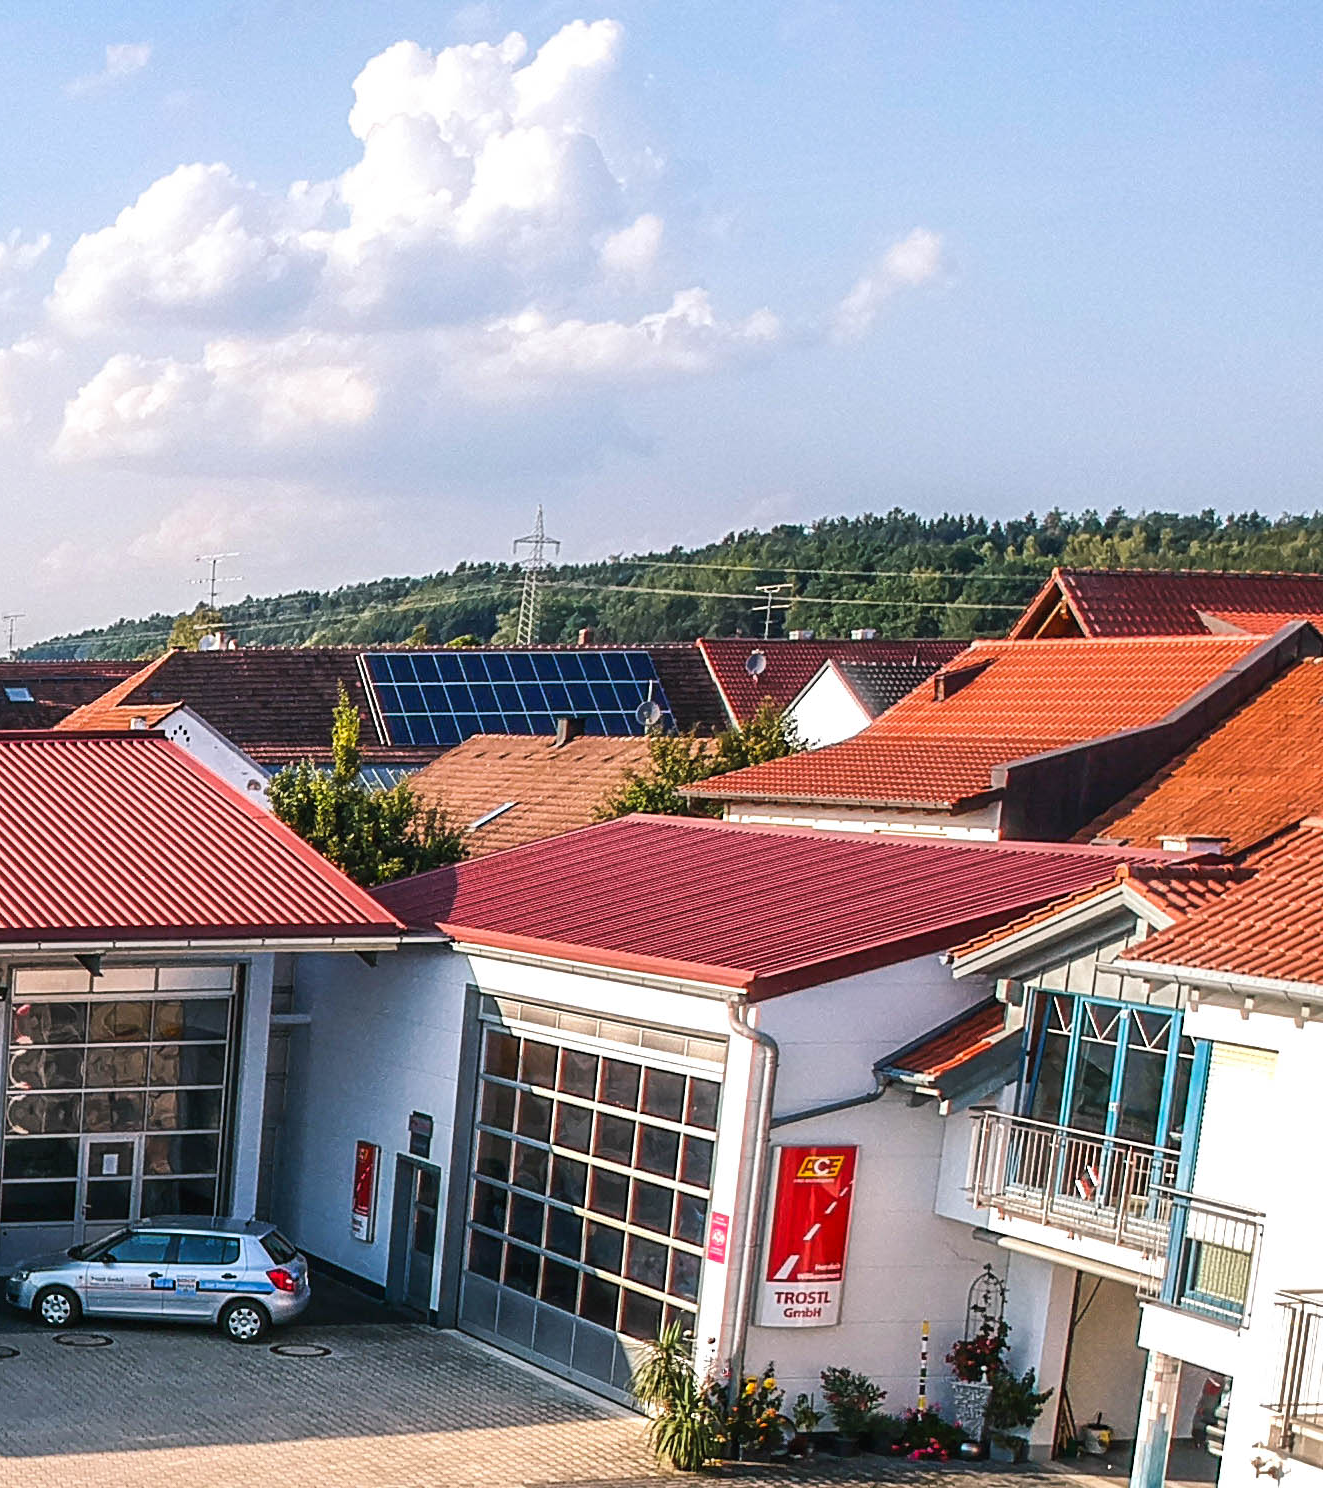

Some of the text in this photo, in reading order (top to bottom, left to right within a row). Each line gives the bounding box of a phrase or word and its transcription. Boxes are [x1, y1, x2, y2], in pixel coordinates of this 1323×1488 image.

[798, 1157, 843, 1176] ACE
[774, 1291, 832, 1305] TROSTL
[783, 1307, 822, 1318] GmbH
